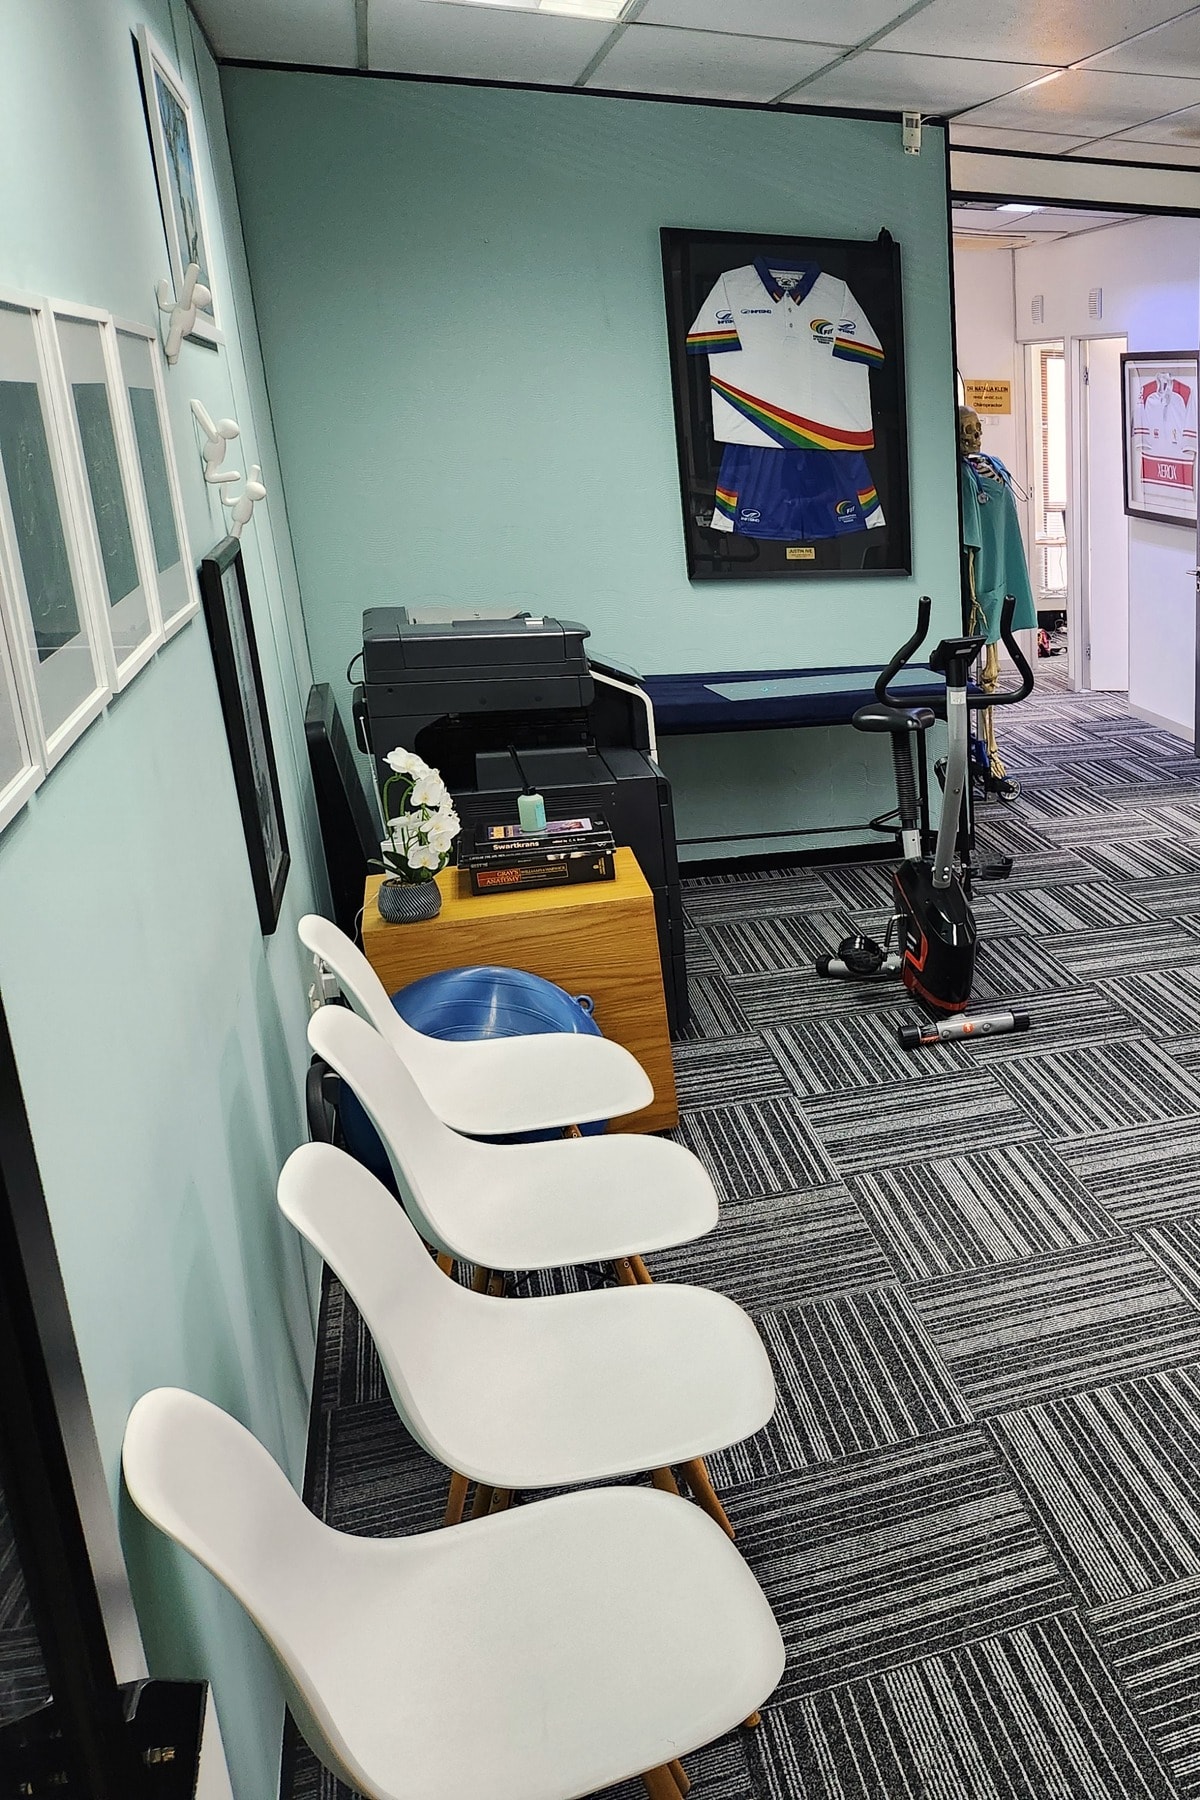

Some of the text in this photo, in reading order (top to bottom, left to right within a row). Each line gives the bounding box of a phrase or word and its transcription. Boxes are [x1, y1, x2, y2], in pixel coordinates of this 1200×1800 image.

[1158, 463, 1177, 480] XEROX
[493, 840, 540, 851] Swartkrans
[486, 876, 520, 885] ANATOMY
